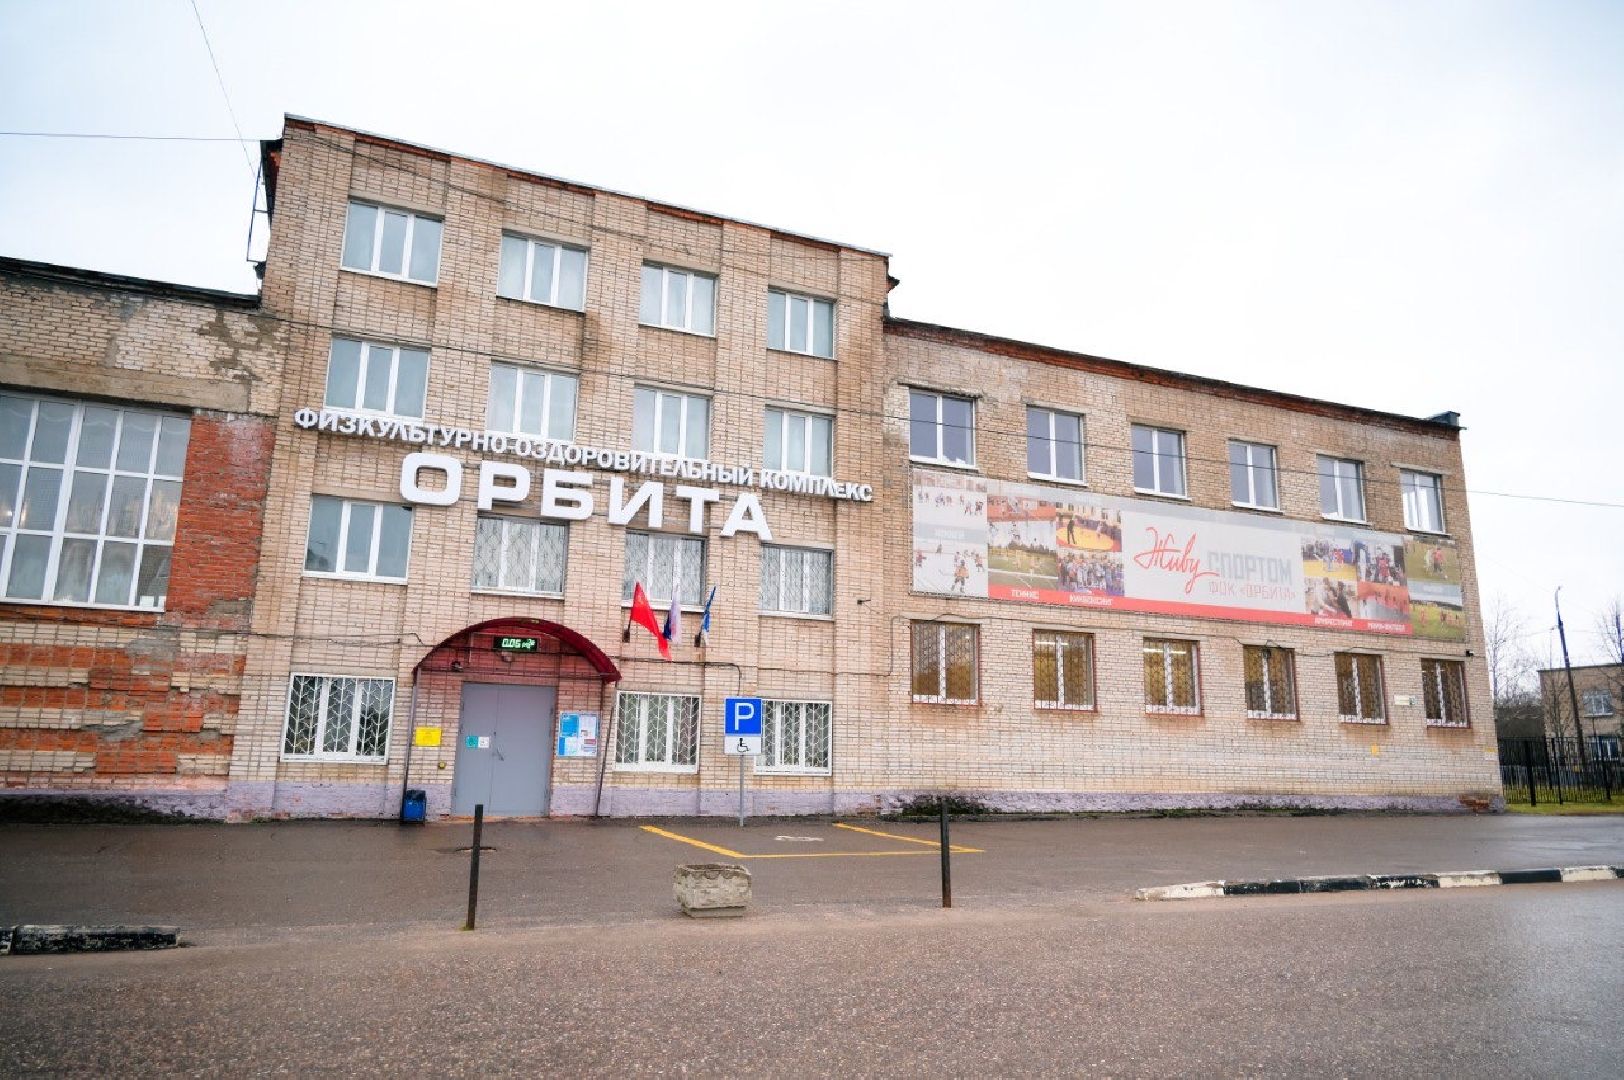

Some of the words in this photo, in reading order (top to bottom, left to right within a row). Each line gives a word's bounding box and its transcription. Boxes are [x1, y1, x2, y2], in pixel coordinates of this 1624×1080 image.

[294, 407, 753, 486] ФИЗКУЛЬТУРНО-ОЗДОРОВИТЕЛЬНЫЙ
[760, 468, 873, 502] КОМПЛЕКС
[401, 452, 773, 541] ОРБИТА
[1133, 526, 1220, 594] Живу
[1208, 551, 1293, 585] СПОРТОМ
[734, 702, 755, 731] P
